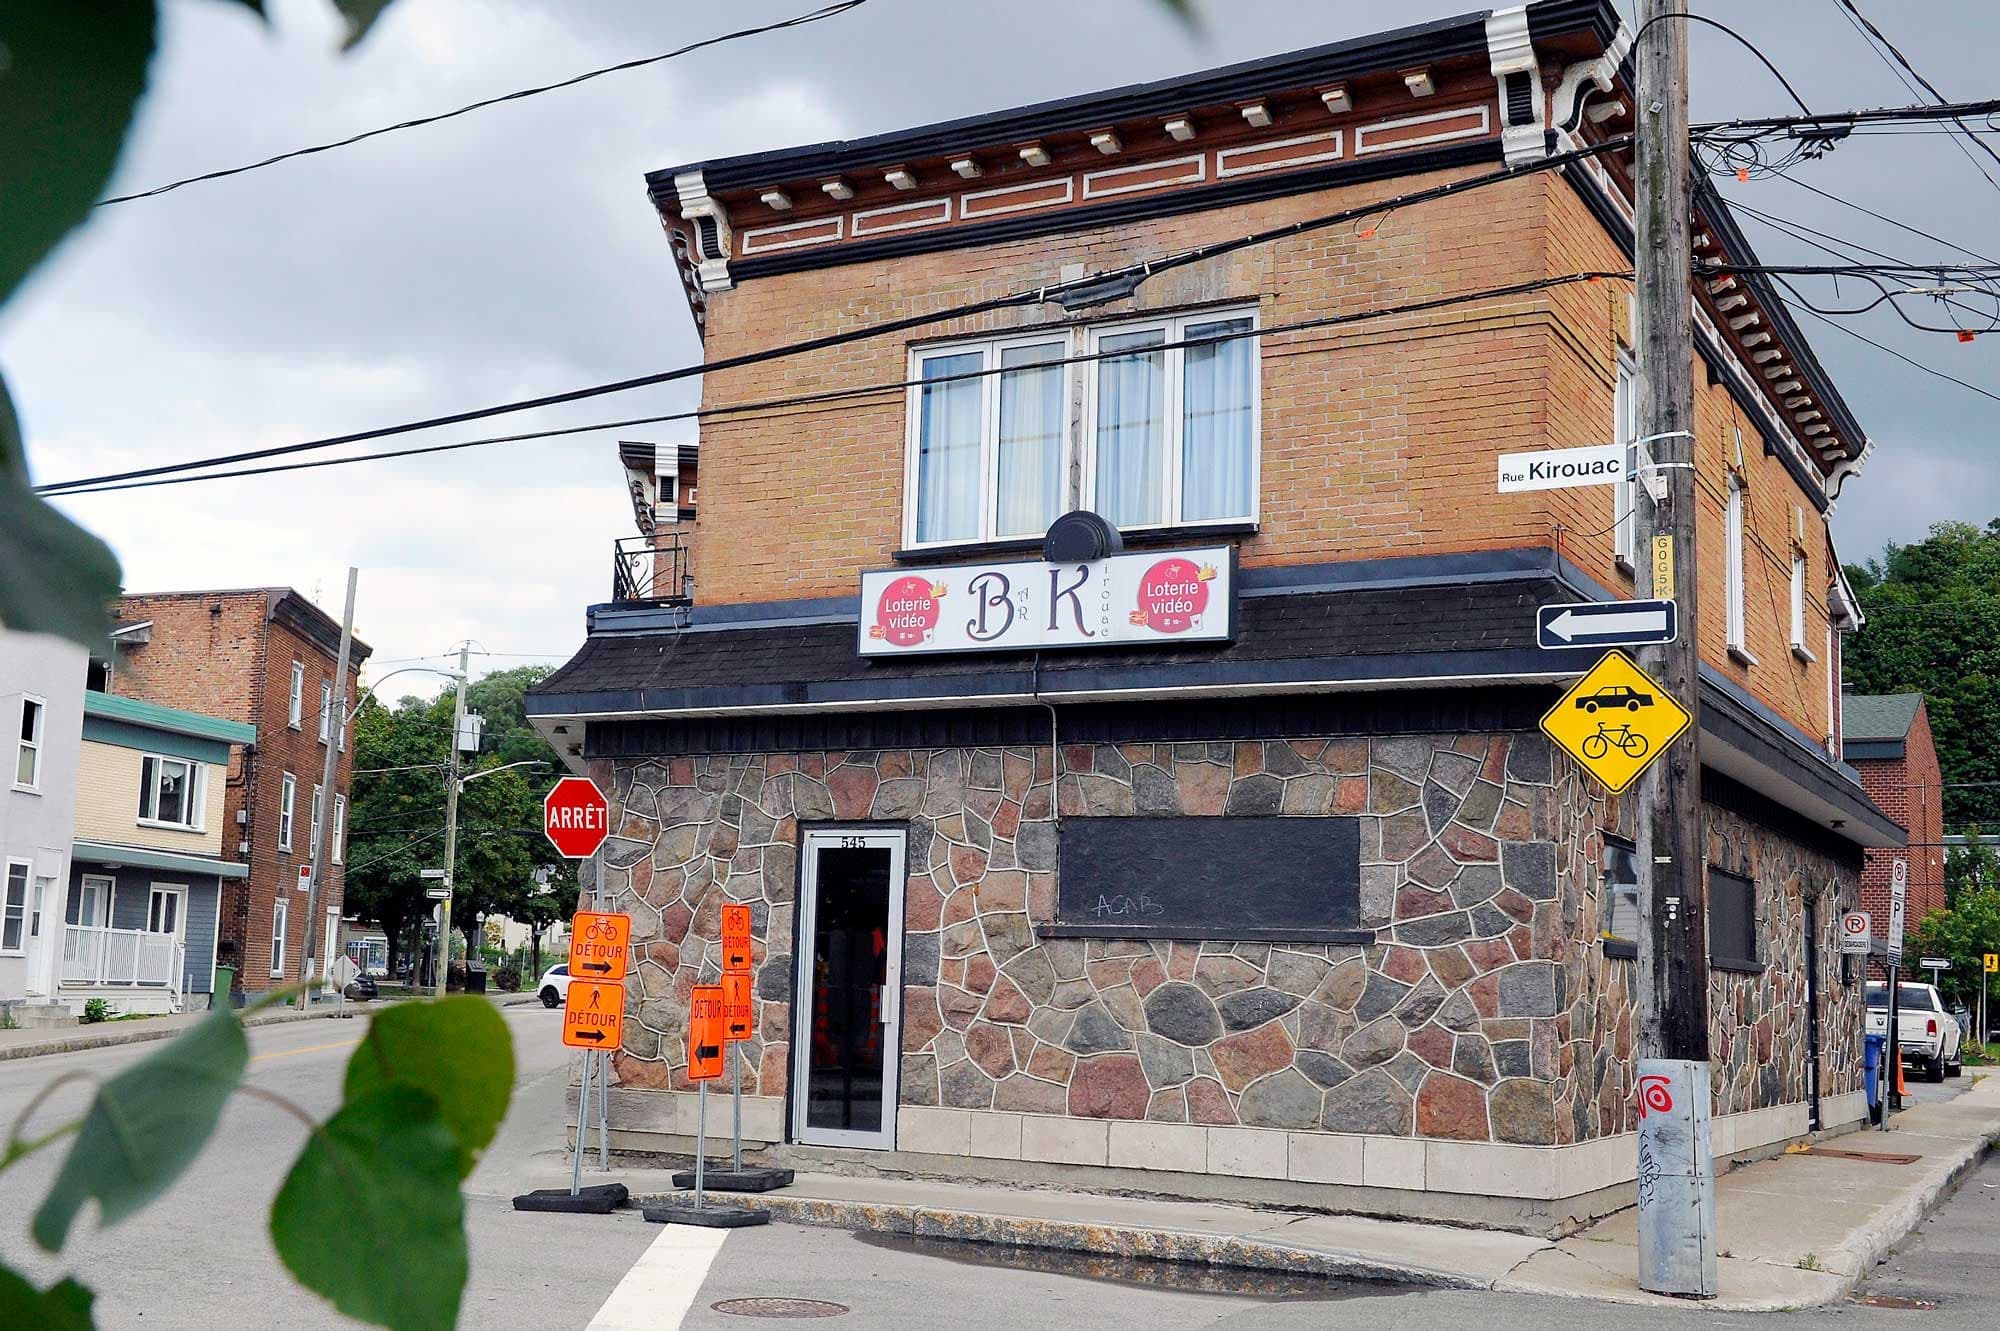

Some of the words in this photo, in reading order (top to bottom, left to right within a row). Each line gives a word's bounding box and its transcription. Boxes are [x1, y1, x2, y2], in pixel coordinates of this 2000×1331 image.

[1502, 473, 1525, 483] Rue
[1529, 459, 1620, 481] Kirouac
[1147, 579, 1199, 597] Loterie
[885, 596, 932, 613] Loterie
[1151, 597, 1193, 614] vidéo
[888, 613, 926, 629] vidéo
[549, 803, 605, 829] ARRÊT
[841, 836, 866, 849] 545
[1091, 894, 1165, 918] ACAB
[575, 941, 623, 958] DÉTOUR
[569, 1009, 617, 1027] DÉTOUR
